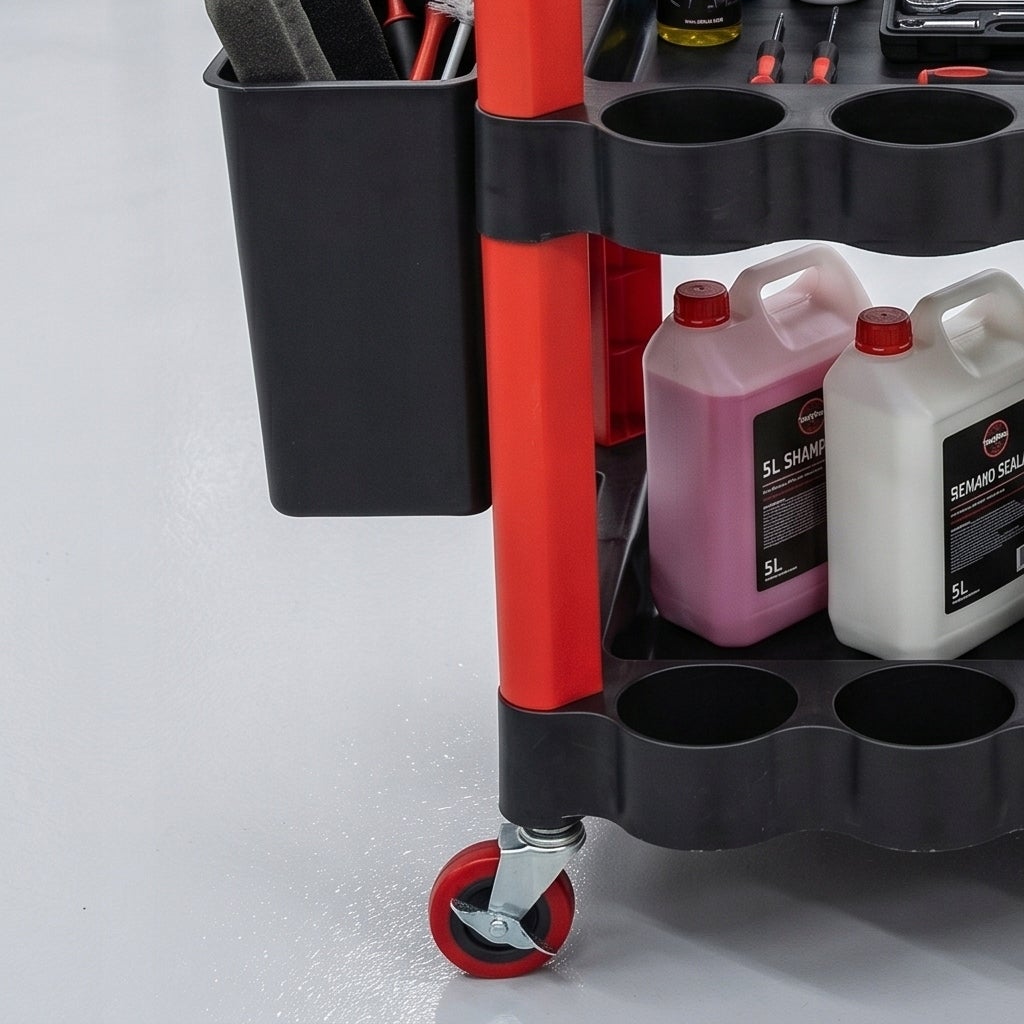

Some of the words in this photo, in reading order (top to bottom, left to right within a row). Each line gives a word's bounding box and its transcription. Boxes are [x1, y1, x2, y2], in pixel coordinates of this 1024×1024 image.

[762, 458, 781, 479] 5L
[784, 438, 825, 470] SHAMP
[764, 557, 783, 577] 5L
[952, 580, 969, 600] 5L
